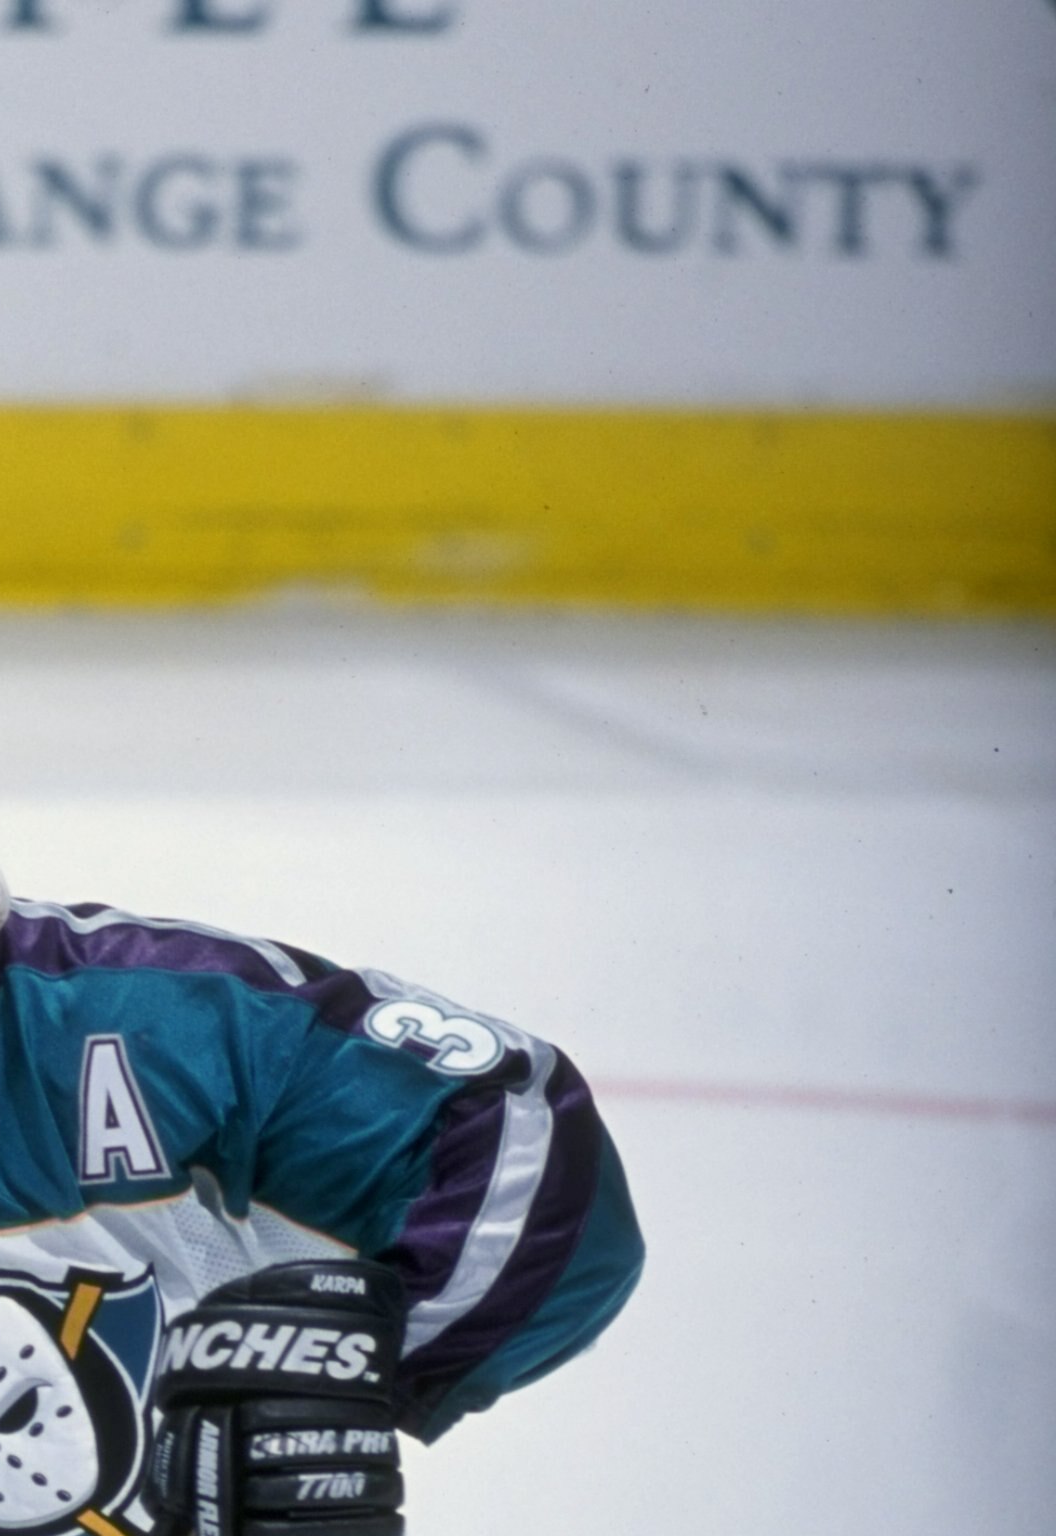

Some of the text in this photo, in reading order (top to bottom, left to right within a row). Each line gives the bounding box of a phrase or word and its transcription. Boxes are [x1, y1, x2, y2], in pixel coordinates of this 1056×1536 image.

[368, 120, 984, 260] COUNTY
[78, 1033, 172, 1184] A
[310, 1274, 366, 1295] KARPA
[195, 1419, 221, 1498] ARMOR
[296, 1472, 366, 1500] 7700
